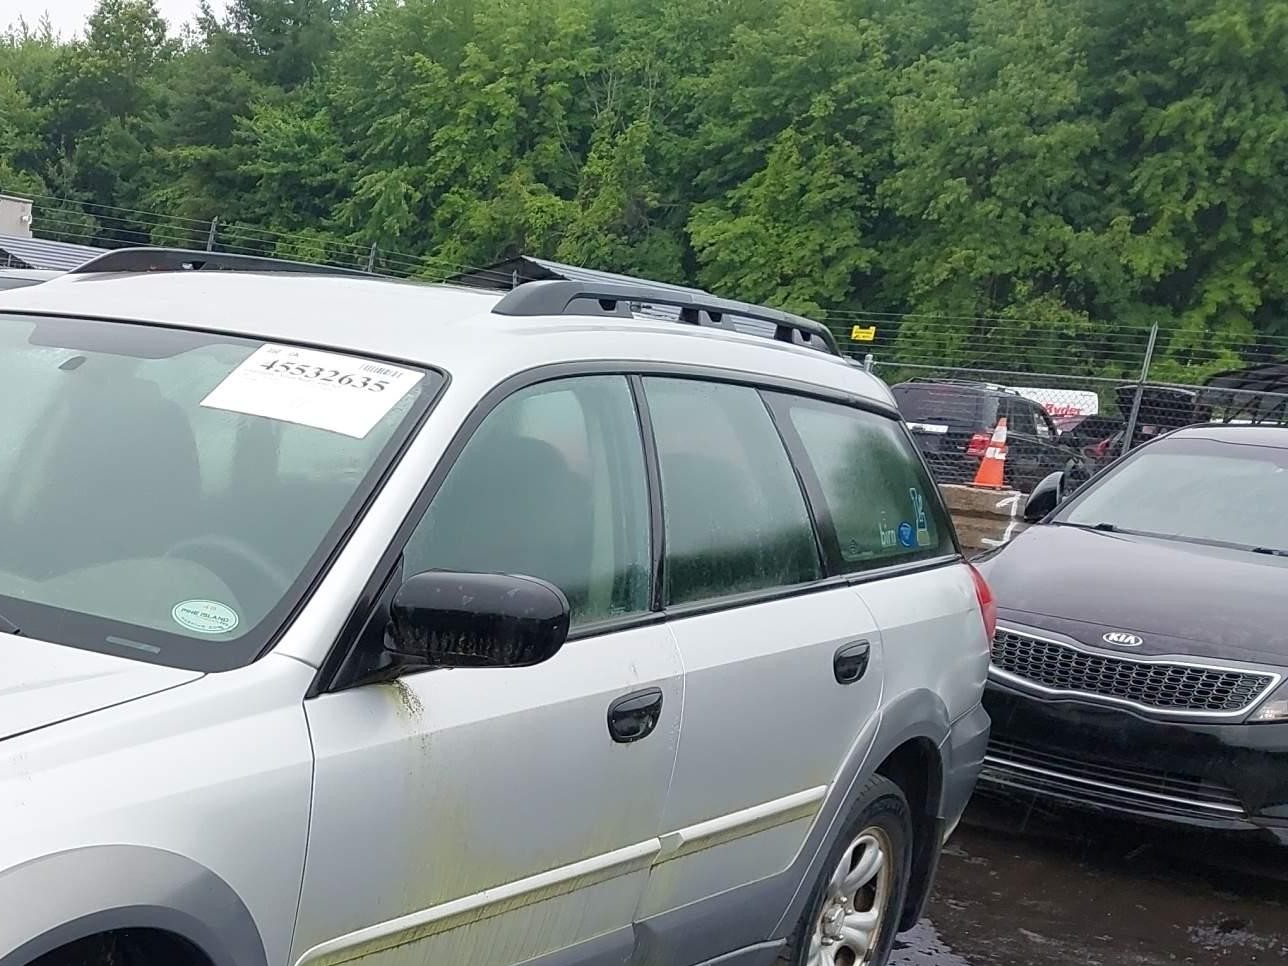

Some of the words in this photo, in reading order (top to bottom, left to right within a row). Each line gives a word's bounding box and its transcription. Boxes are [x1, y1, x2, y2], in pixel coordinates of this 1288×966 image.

[259, 359, 391, 393] 45532635
[199, 611, 230, 623] ISLAND
[1108, 632, 1136, 644] KIA
